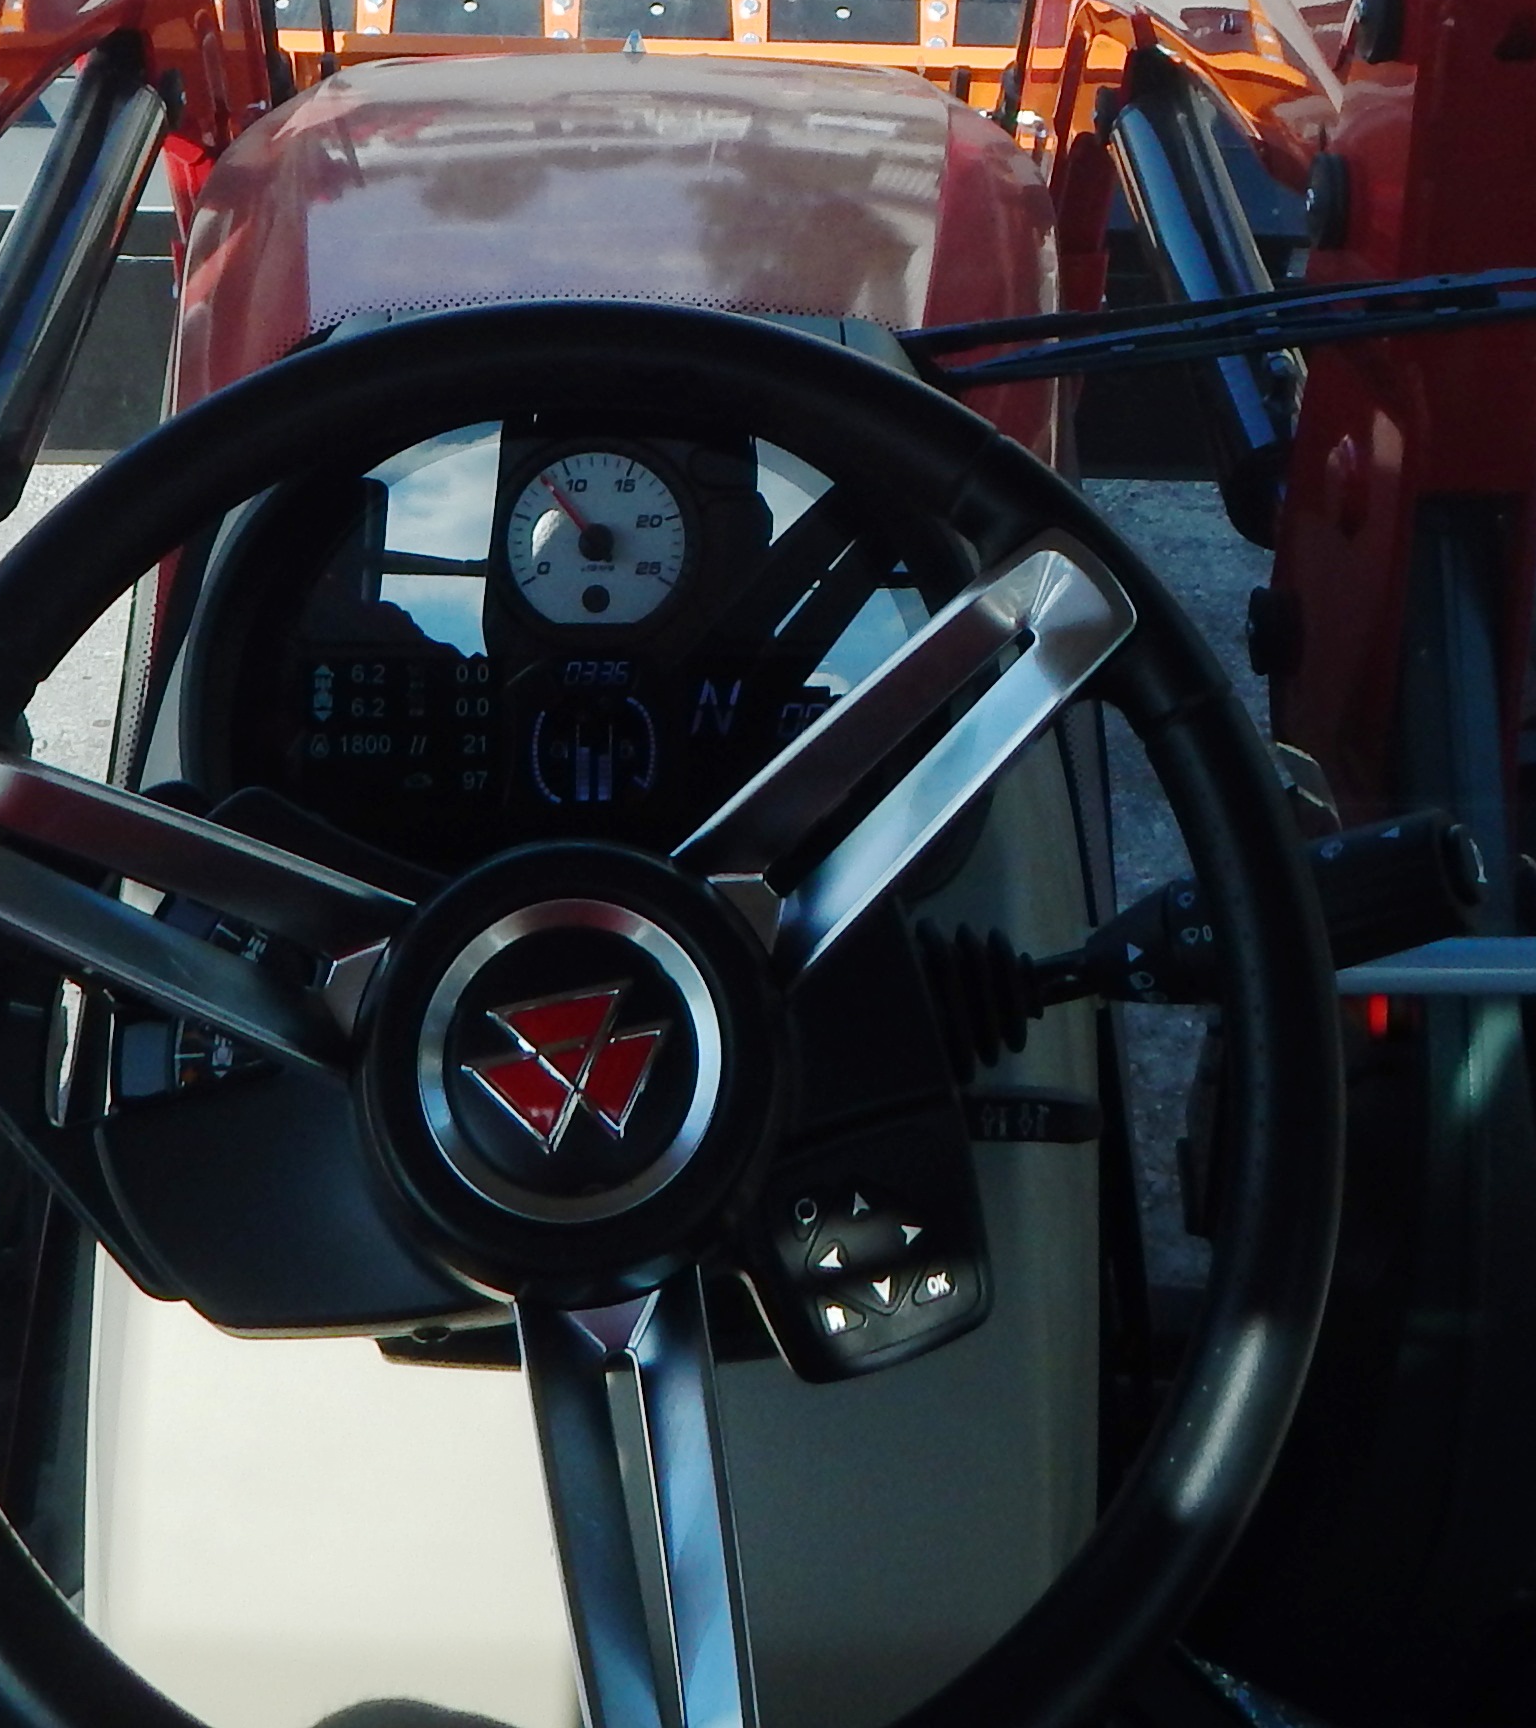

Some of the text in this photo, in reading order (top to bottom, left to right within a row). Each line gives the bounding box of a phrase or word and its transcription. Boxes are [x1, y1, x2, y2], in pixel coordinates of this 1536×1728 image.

[566, 478, 588, 493] 10
[615, 478, 636, 493] 15
[635, 514, 663, 529] 20
[536, 561, 551, 575] 0
[634, 561, 662, 575] 25
[351, 664, 386, 684] 6.2
[455, 663, 490, 683] 0.0
[351, 698, 386, 718] 6.2
[455, 697, 490, 717] 0.0
[690, 678, 742, 736] N
[340, 734, 392, 755] 1800
[463, 734, 487, 755] 21
[463, 771, 489, 791] 97
[926, 1272, 952, 1295] OK
